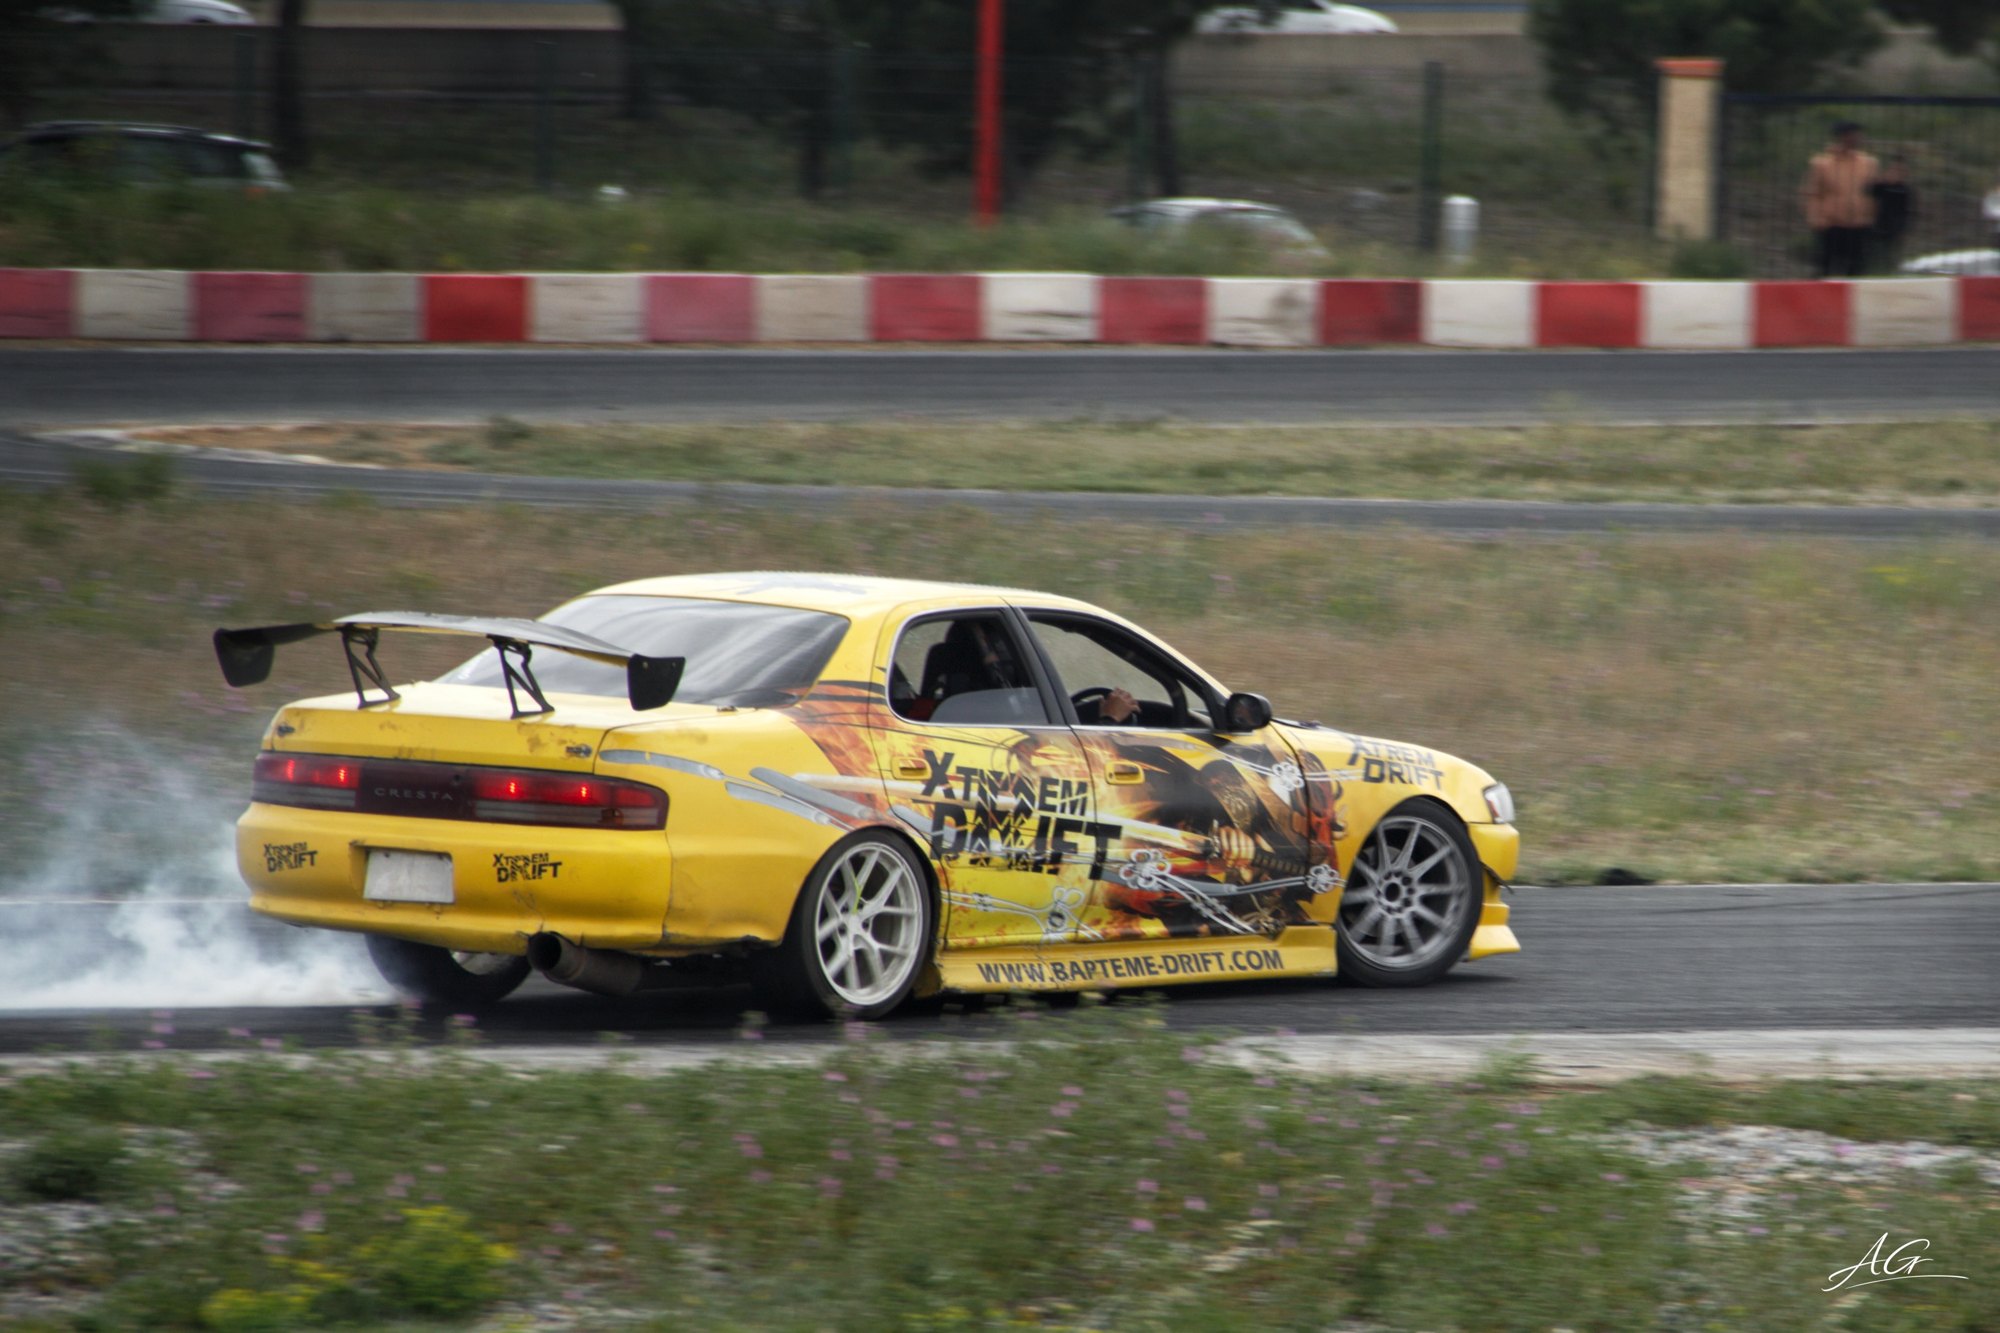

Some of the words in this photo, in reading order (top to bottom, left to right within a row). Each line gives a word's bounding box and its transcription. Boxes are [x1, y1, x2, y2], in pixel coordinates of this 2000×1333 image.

[1346, 736, 1436, 769] XTREM
[1362, 756, 1444, 791] DRIFT
[374, 787, 453, 800] CRESTA
[976, 949, 1285, 984] WWW.BAPTEME-DRIFT.COM
